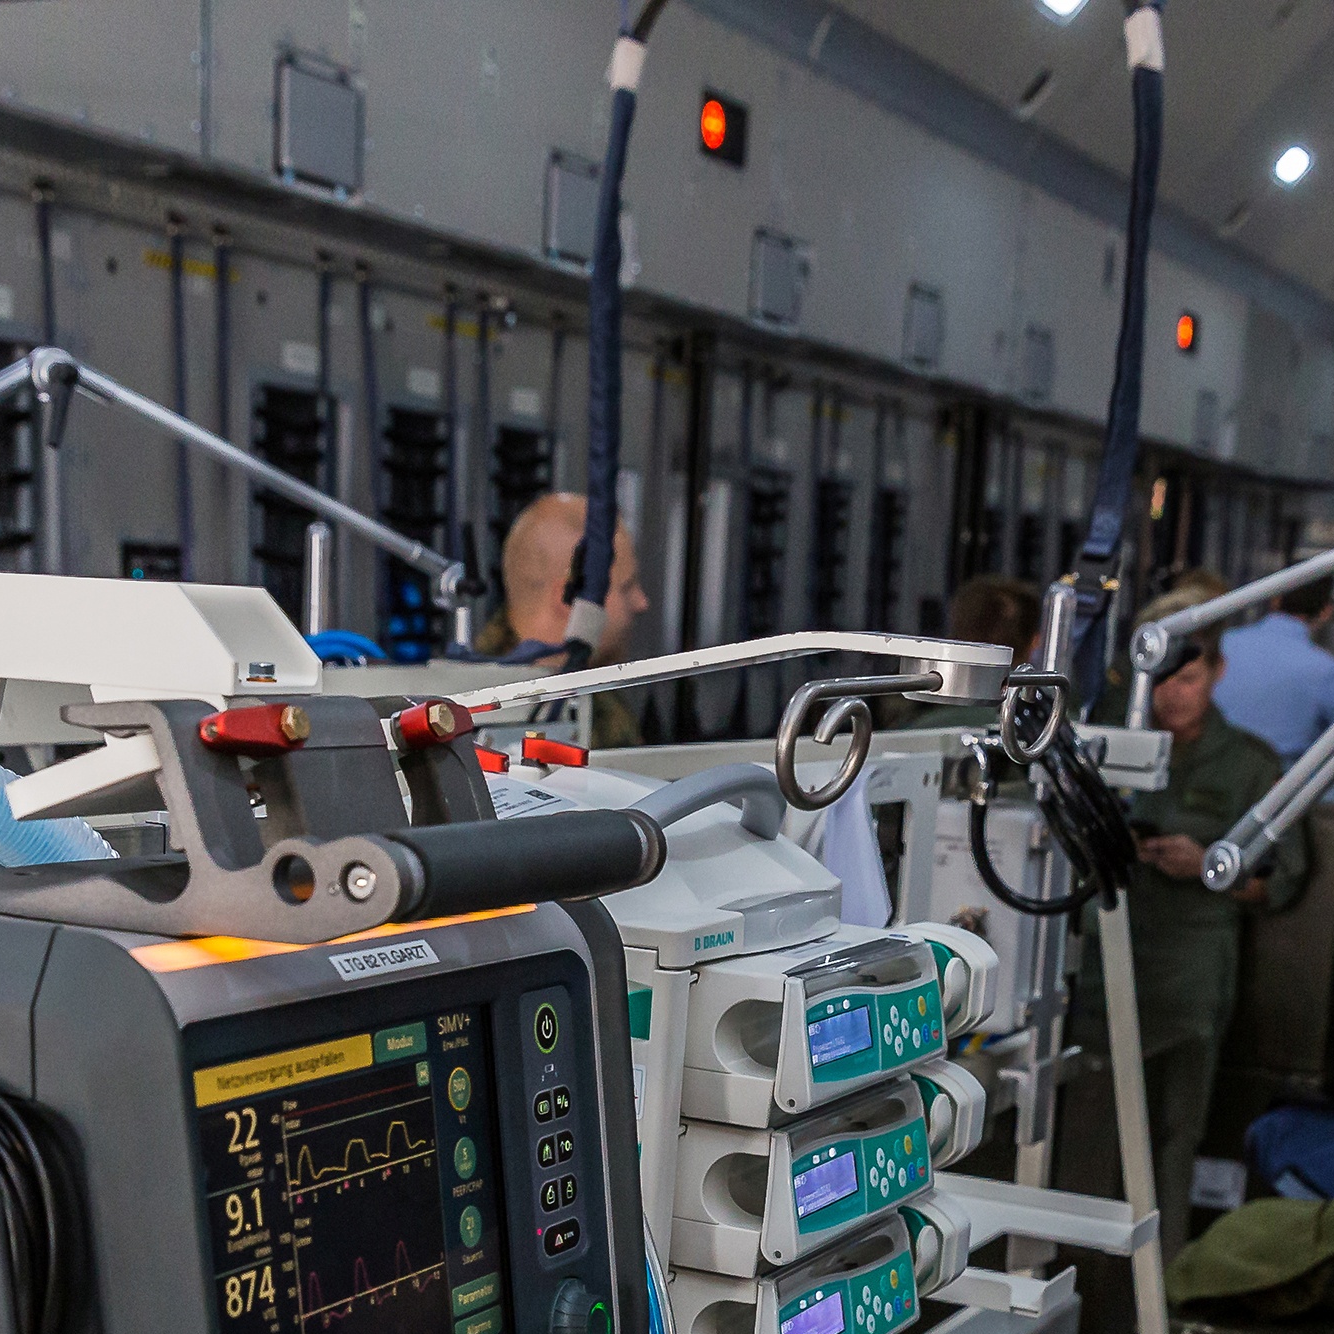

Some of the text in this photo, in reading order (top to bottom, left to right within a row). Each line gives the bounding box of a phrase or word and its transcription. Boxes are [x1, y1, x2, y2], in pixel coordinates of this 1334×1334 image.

[338, 957, 365, 974] LTG
[377, 944, 429, 967] FLGARZT
[703, 930, 735, 950] BRAUN
[437, 1012, 471, 1035] SIMV+
[225, 1107, 260, 1153] 22
[225, 1187, 263, 1237] 9.1
[225, 1265, 276, 1319] 874
